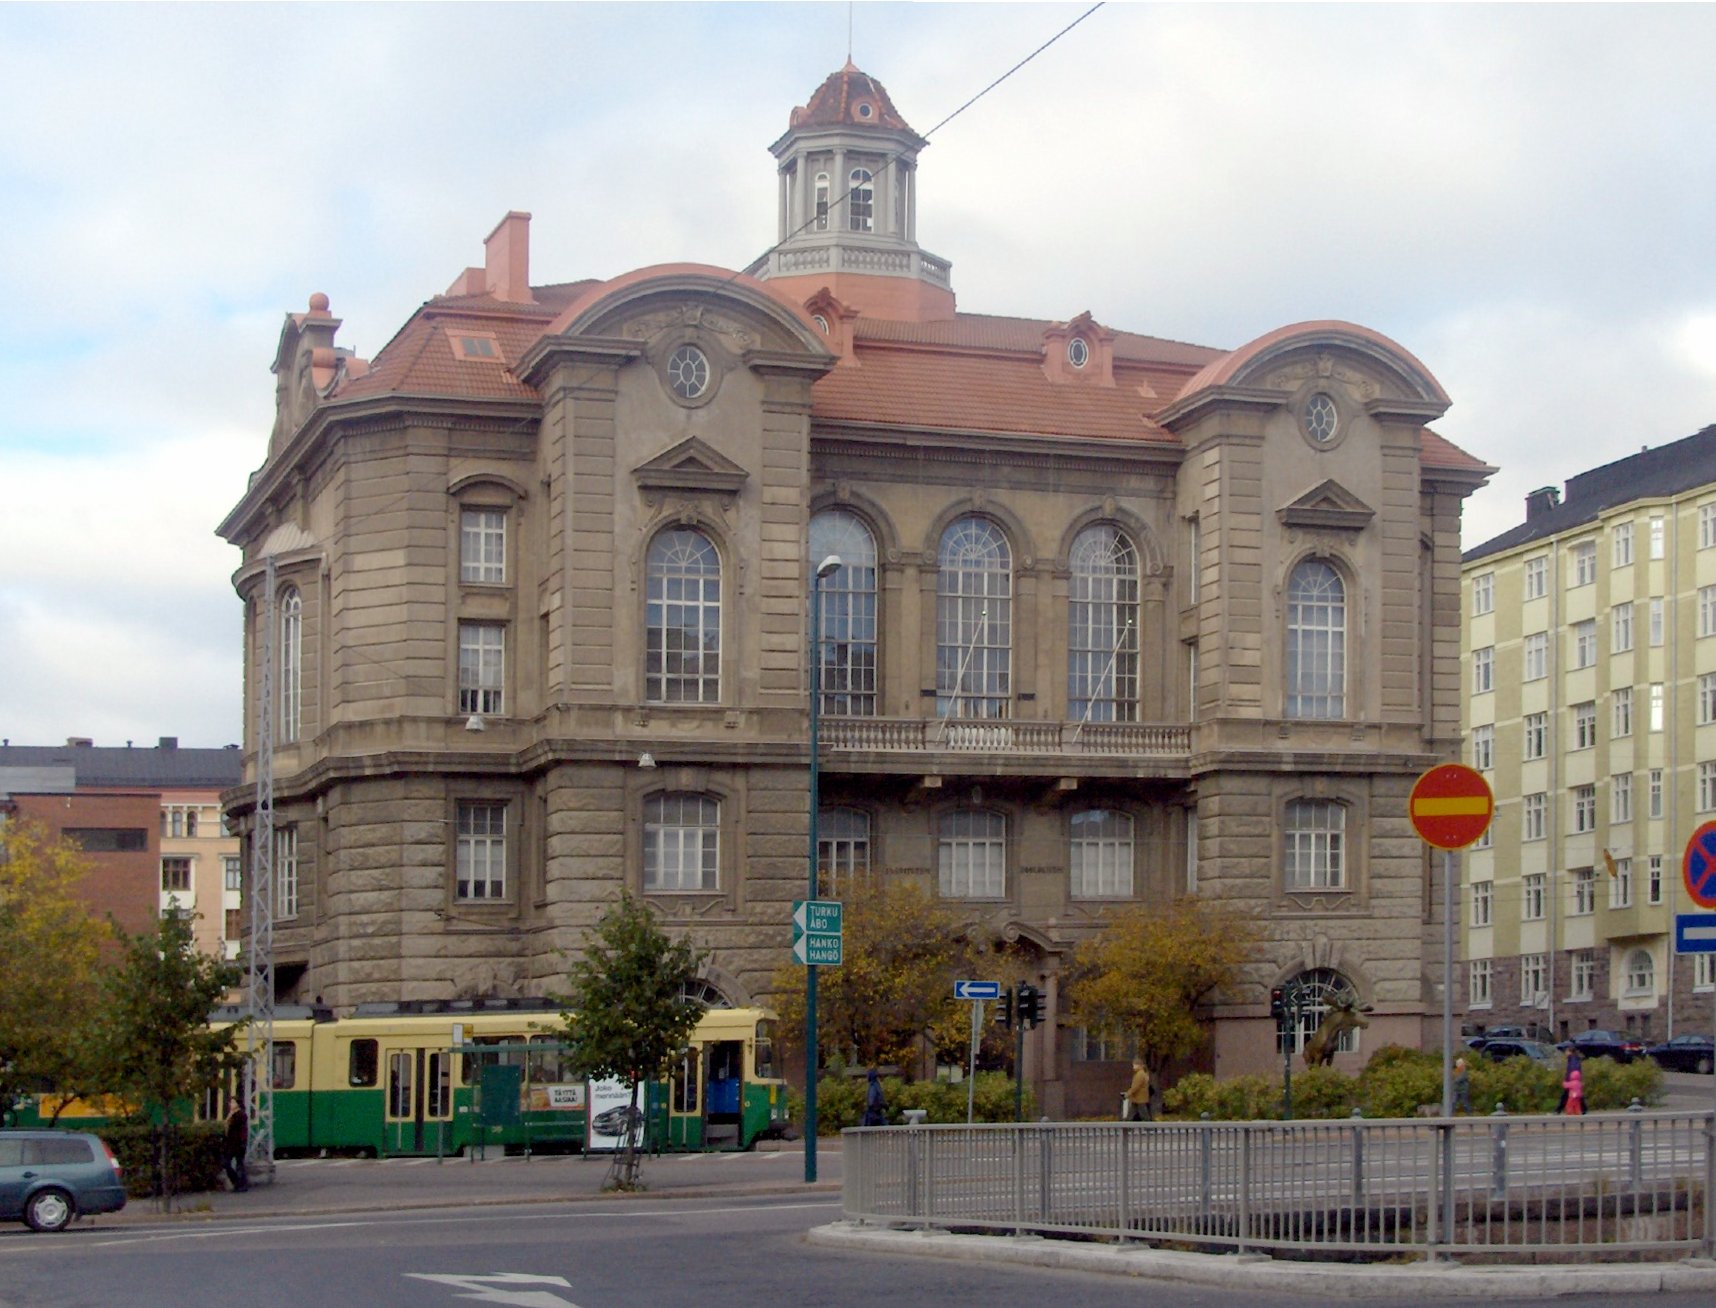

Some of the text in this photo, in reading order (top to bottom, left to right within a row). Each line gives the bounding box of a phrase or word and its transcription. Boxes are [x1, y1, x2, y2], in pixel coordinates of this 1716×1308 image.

[810, 905, 838, 917] TURKU
[810, 917, 828, 929] ÅBO
[809, 937, 839, 948] HANKO
[809, 949, 839, 961] HANGÖ
